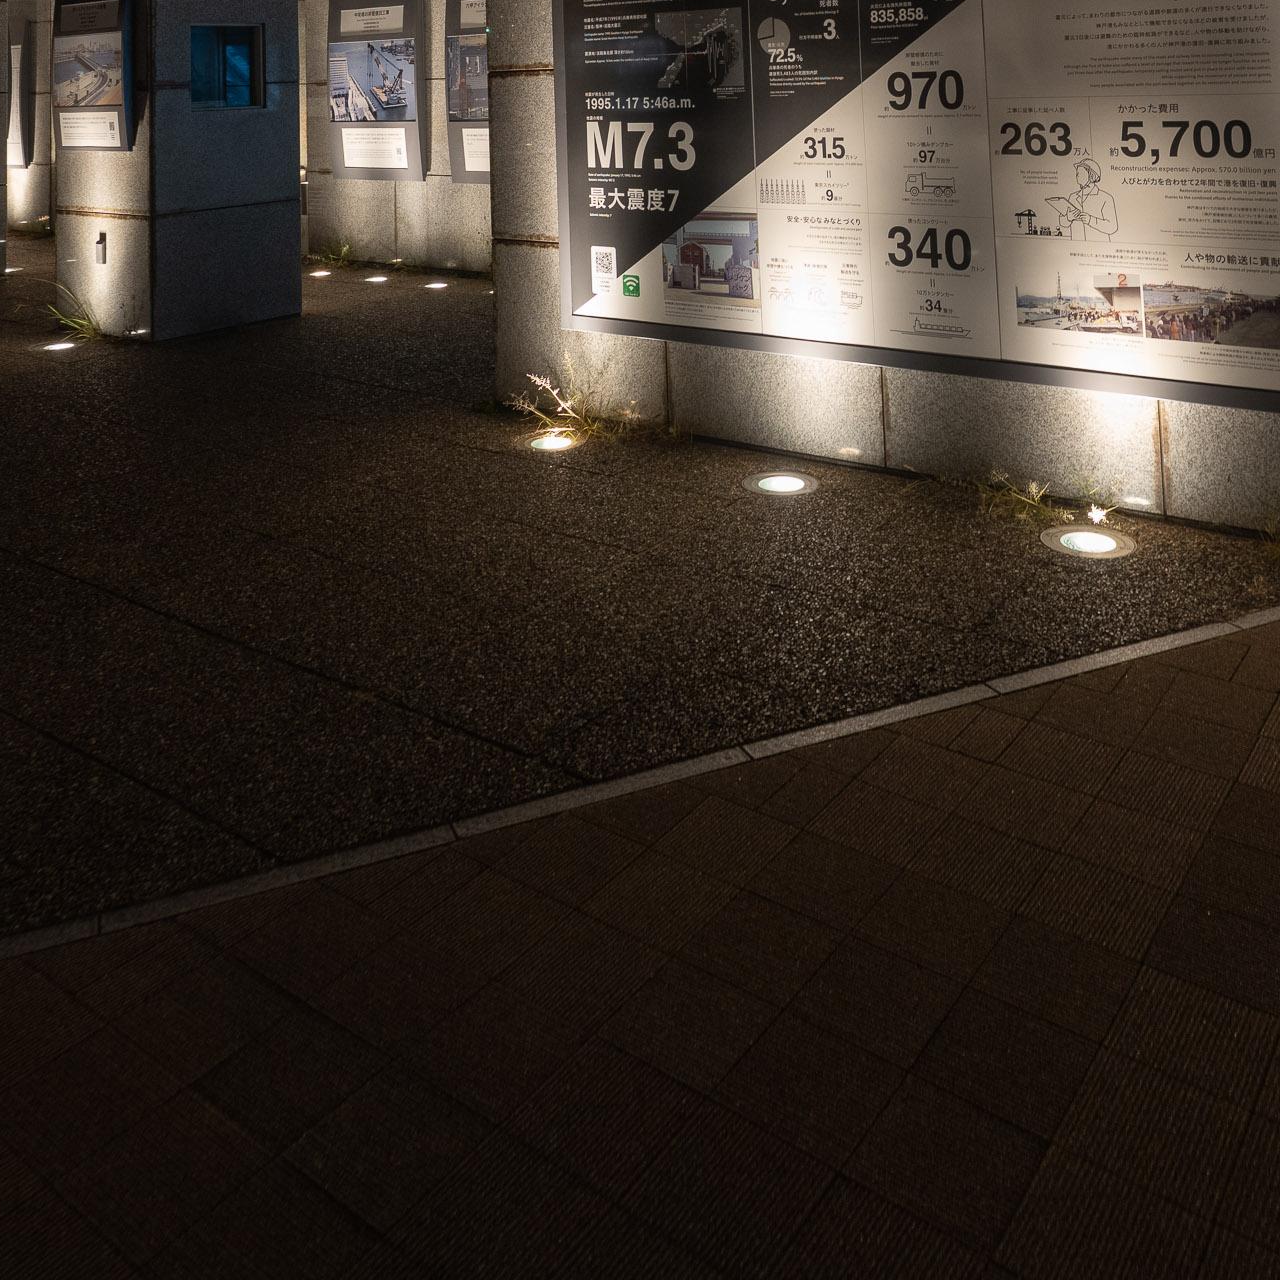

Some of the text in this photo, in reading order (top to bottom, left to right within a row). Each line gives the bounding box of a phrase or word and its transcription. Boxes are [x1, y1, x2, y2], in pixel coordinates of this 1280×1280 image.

[585, 96, 696, 110] 1995.1.17 5:46a.m.
[1118, 104, 1179, 114] かかった費用
[586, 121, 696, 171] M7.3
[1192, 166, 1216, 174] Approx.
[1122, 178, 1277, 189] 人びとが力を合わせて2年間で港を復旧・復興
[589, 187, 680, 211] 最大震度7
